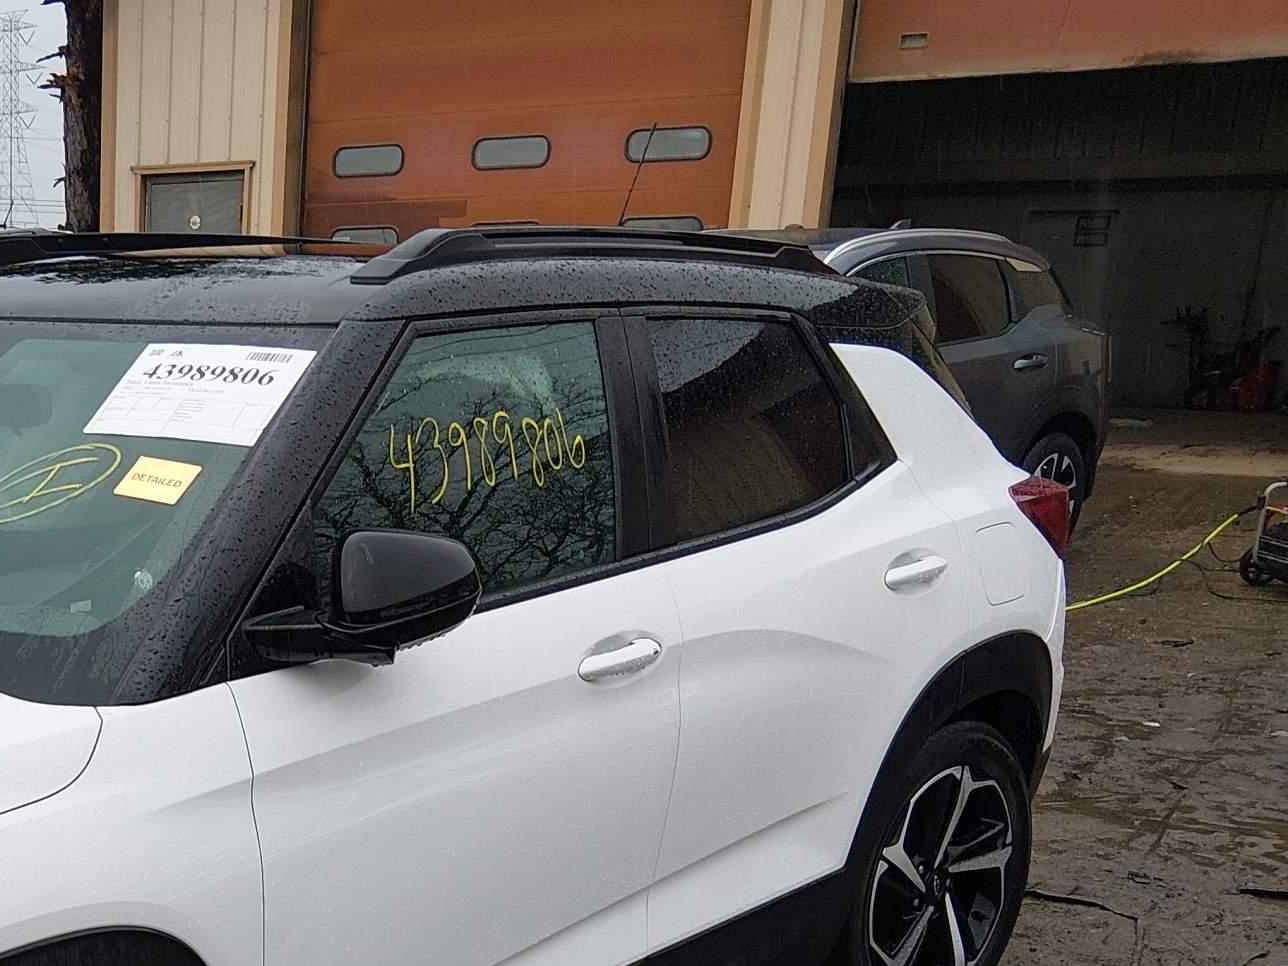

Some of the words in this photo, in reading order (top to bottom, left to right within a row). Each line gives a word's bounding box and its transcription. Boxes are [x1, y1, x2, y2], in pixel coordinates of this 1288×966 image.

[142, 362, 280, 386] 43989806
[389, 407, 586, 514] 43989806
[130, 472, 183, 488] DETAILED
